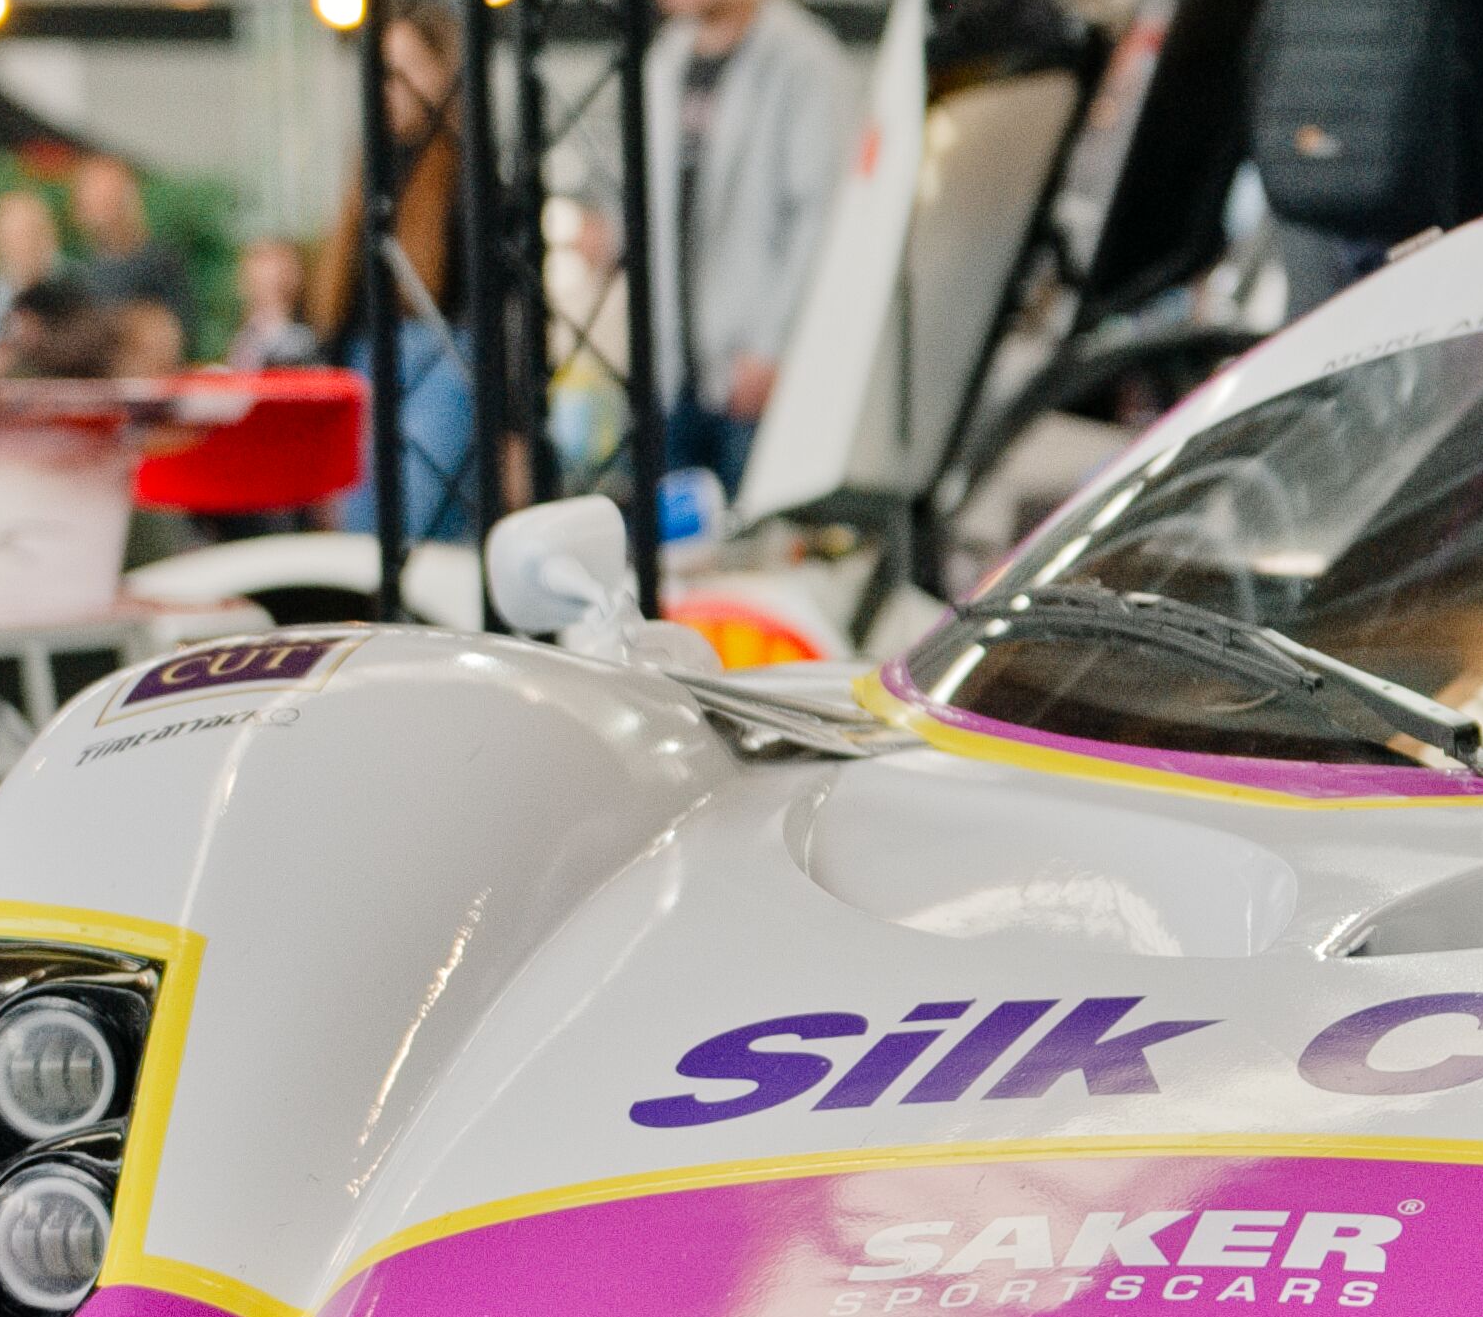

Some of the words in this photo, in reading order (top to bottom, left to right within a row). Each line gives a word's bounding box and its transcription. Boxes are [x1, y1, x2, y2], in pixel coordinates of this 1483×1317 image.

[1322, 324, 1439, 372] MORE
[161, 644, 311, 684] CUT
[629, 996, 1226, 1128] Silk
[829, 1274, 1378, 1317] SPORTSCARS
